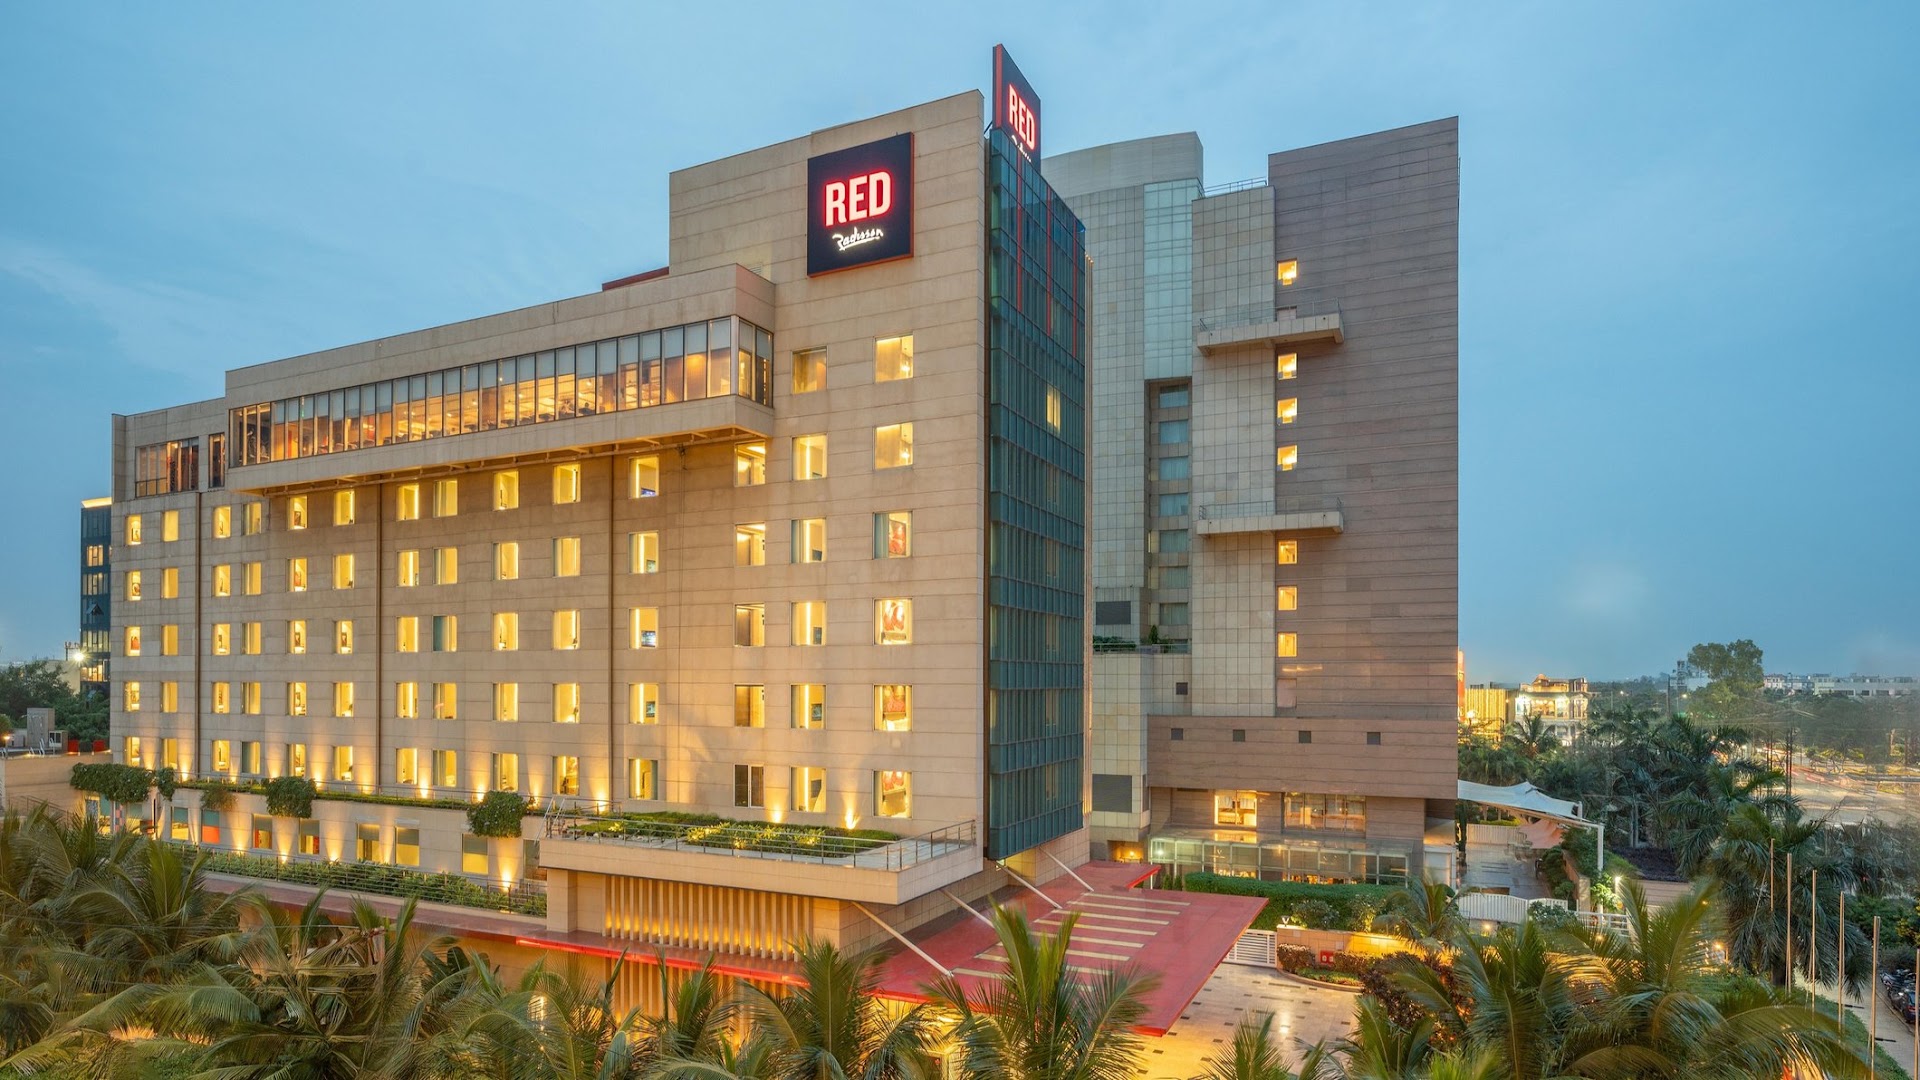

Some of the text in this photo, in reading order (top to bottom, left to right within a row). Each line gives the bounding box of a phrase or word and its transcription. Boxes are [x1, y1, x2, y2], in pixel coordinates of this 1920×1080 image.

[1009, 83, 1035, 150] RED
[826, 171, 891, 227] RED
[832, 226, 884, 251] Radisson
